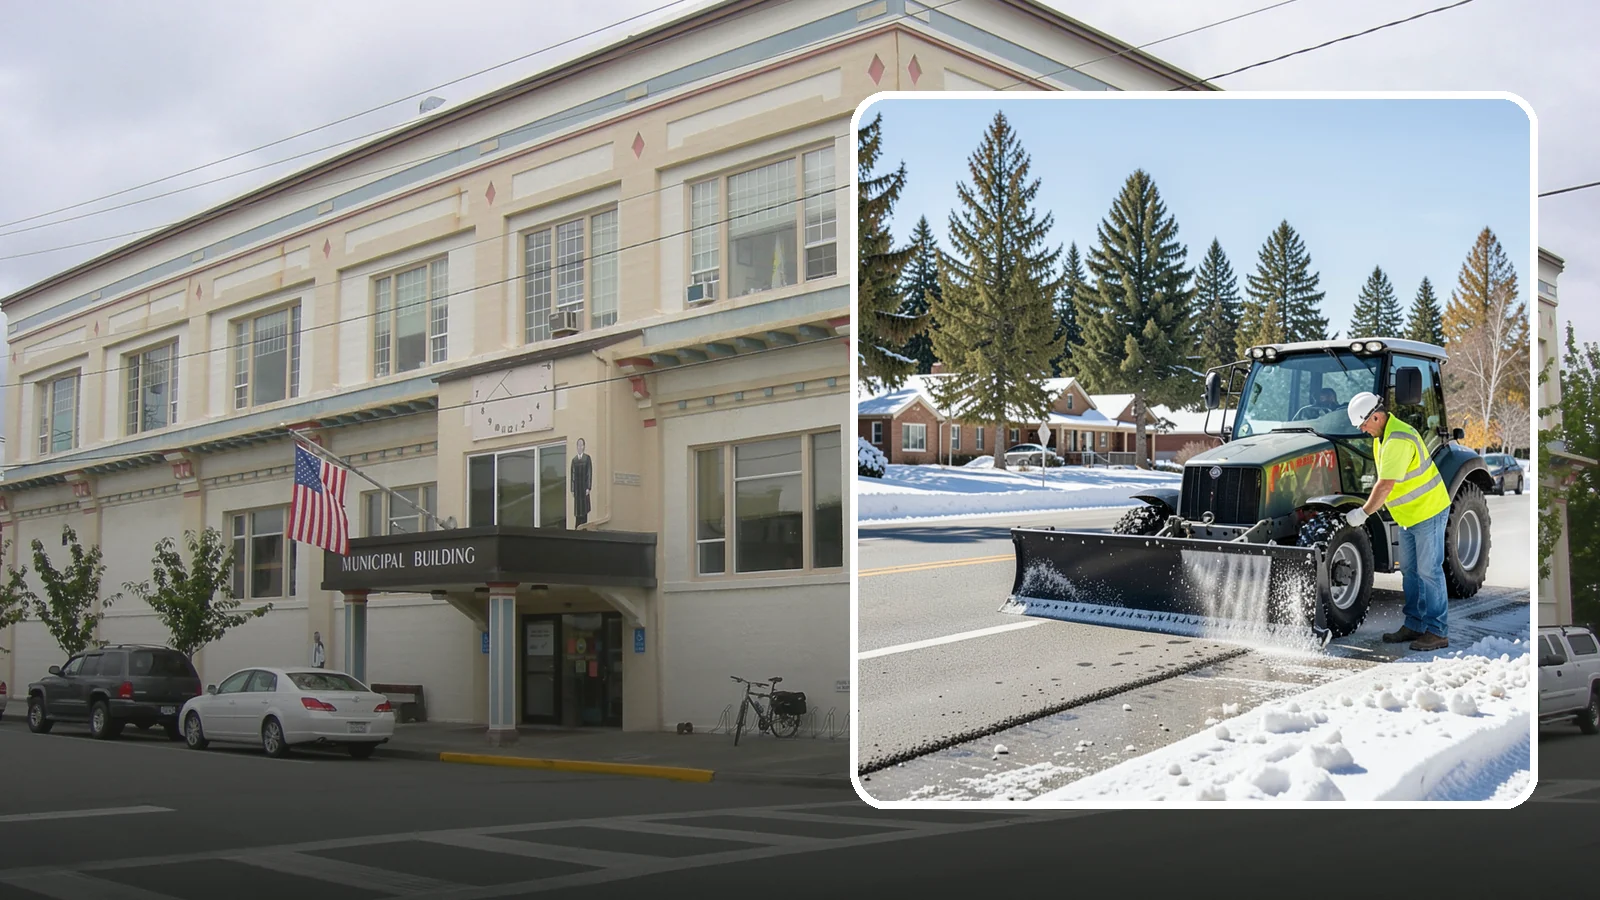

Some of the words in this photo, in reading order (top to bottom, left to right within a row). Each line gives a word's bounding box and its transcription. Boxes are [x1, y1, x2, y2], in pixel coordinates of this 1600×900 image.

[481, 407, 485, 415] 8
[488, 417, 492, 425] 9
[507, 425, 513, 433] 12
[521, 420, 525, 428] 2
[529, 414, 533, 422] 3
[536, 402, 540, 410] 4
[342, 552, 405, 572] MUNICIPAL
[414, 546, 475, 567] BUILDING
